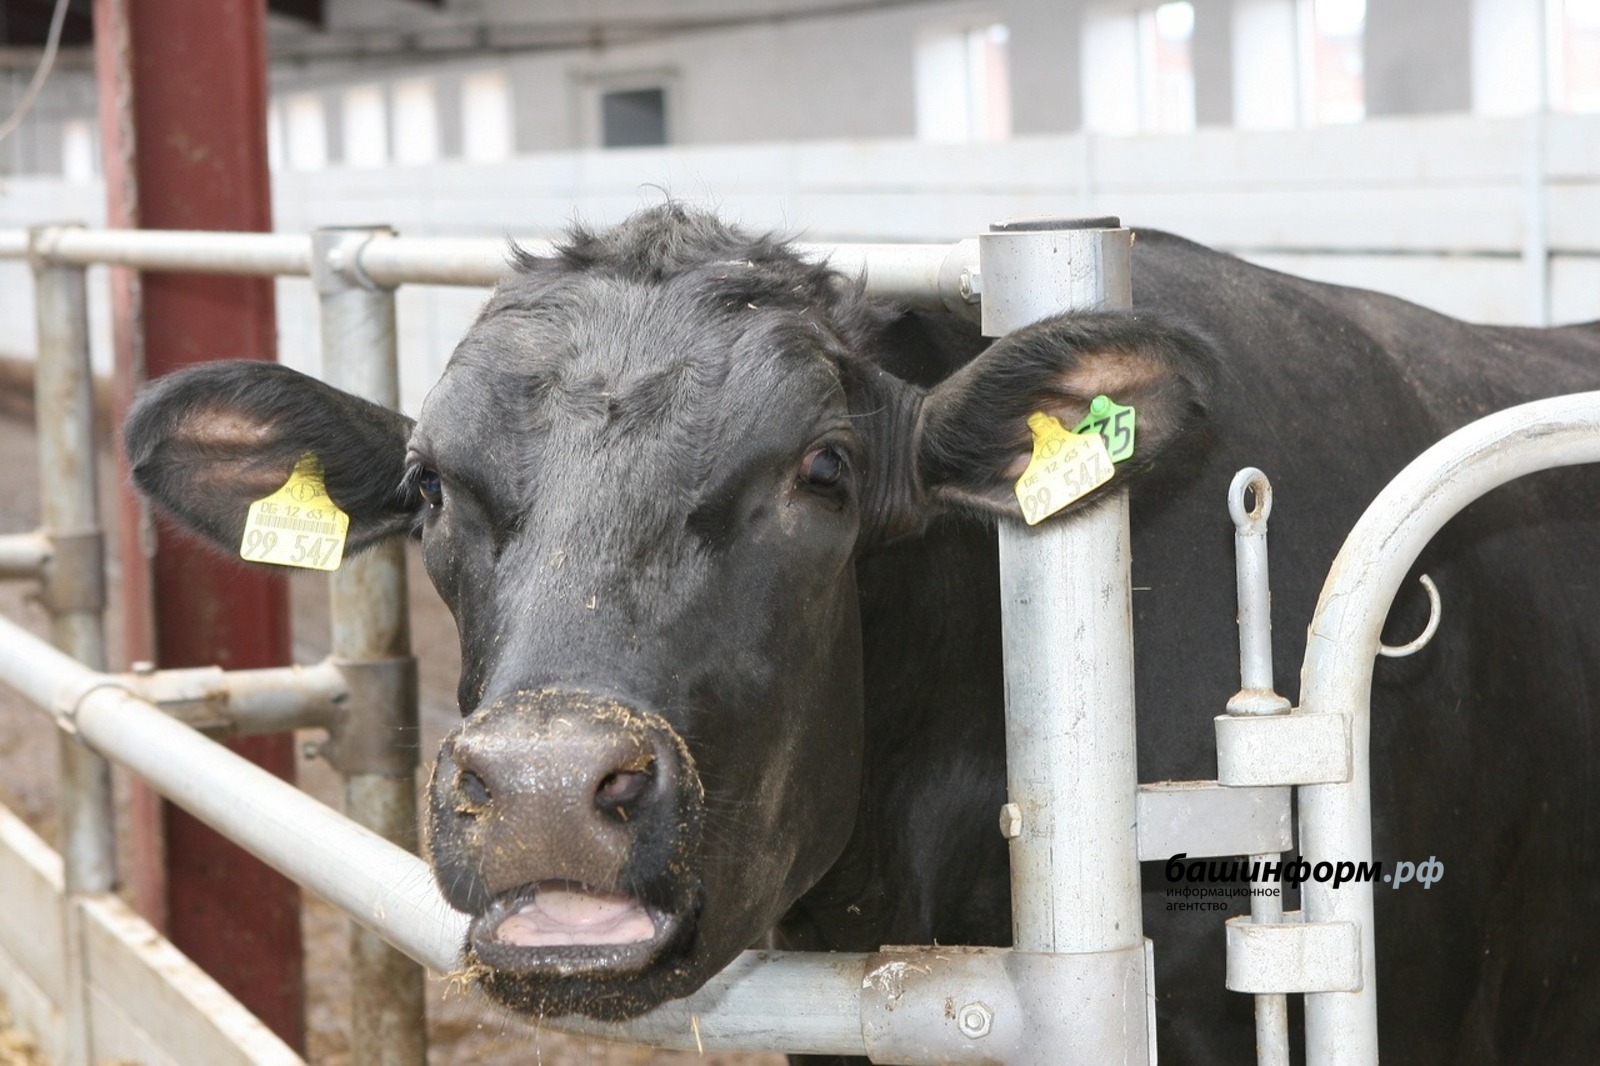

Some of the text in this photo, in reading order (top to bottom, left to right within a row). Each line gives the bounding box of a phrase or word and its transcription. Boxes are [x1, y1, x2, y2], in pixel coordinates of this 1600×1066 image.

[1078, 409, 1131, 456] 35
[1023, 453, 1101, 521] 99 547
[1024, 473, 1040, 488] DE
[1045, 461, 1059, 475] 12
[285, 505, 300, 518] 12
[306, 508, 323, 520] 63
[244, 529, 340, 568] 99 547
